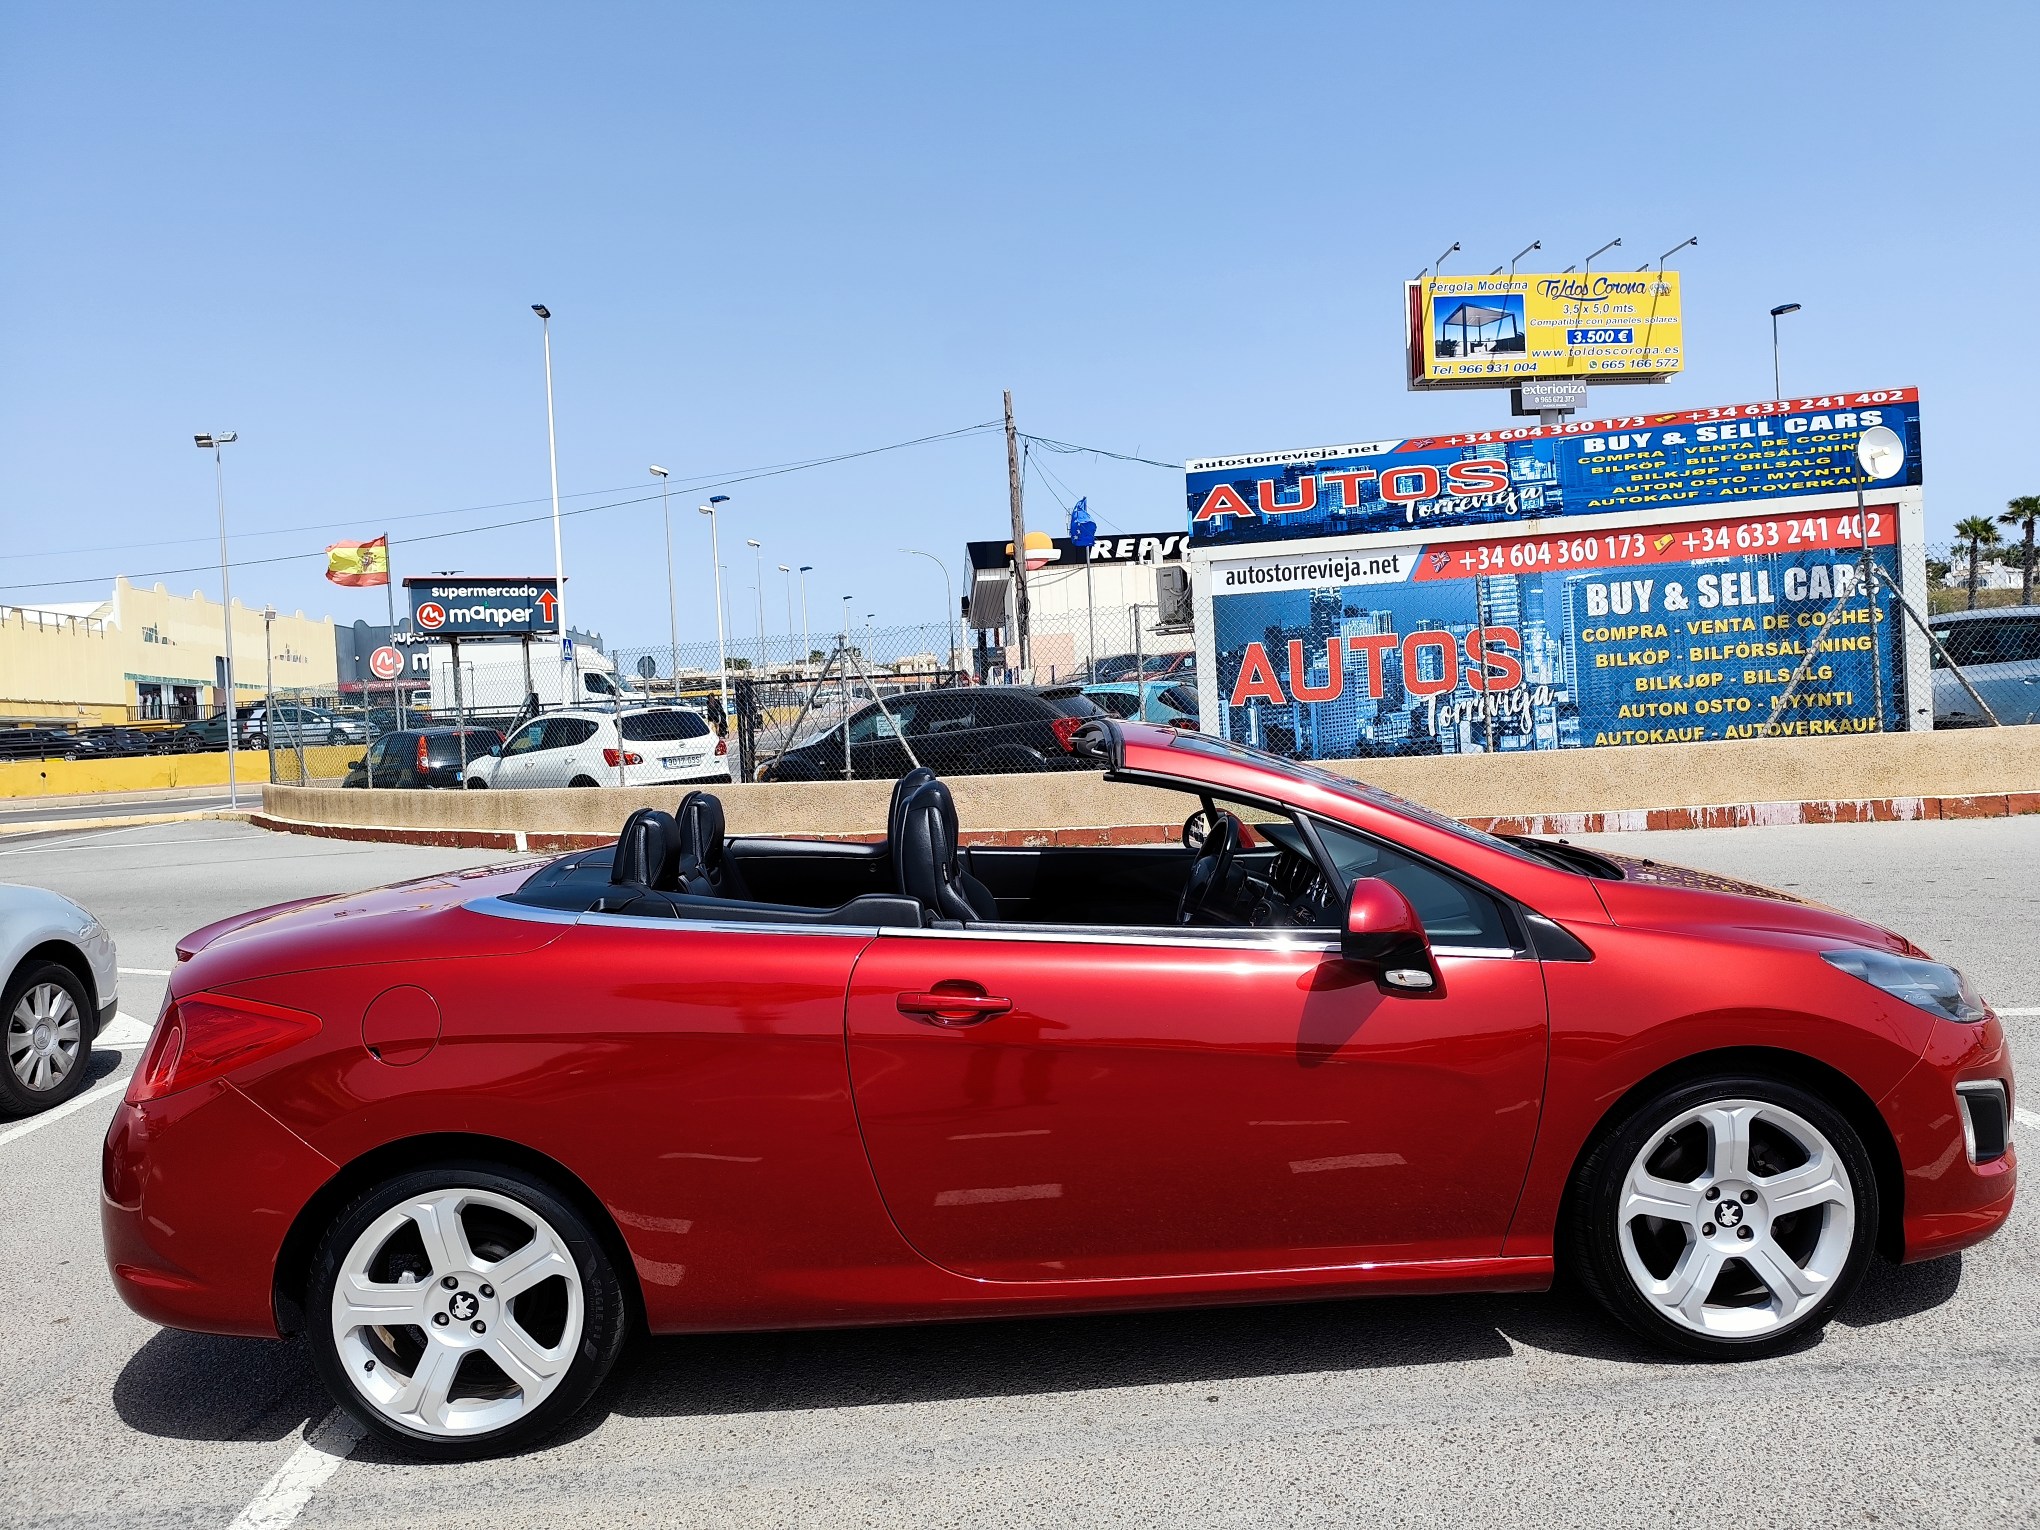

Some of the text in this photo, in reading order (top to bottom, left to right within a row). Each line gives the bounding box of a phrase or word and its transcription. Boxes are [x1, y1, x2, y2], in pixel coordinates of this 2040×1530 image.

[1478, 280, 1528, 291] Moderna
[1537, 277, 1646, 300] Toldos Corona
[1530, 317, 1583, 327] Compatible
[1606, 317, 1642, 326] paneles
[1645, 316, 1678, 324] solares
[1563, 303, 1637, 314] 3,5 x 5,0 mts.
[1573, 330, 1629, 343] 3.500 €
[1531, 346, 1679, 357] www.toldoscorona.es
[1601, 358, 1679, 369] 665 166 572
[1432, 363, 1538, 374] Tel. 966 931 004
[1522, 383, 1586, 395] exterioriza
[1445, 390, 1904, 446] +34 604 360 173 +34 633 241 402
[1583, 410, 1883, 454] BUY & SELL CARS
[1193, 443, 1380, 470] autostorrevieja.net
[1578, 450, 1665, 465] COMPRA
[1684, 441, 1754, 455] VENTA
[1762, 438, 1789, 447] DE
[1796, 431, 1866, 444] COCH
[1591, 461, 1667, 475] BILKÖP
[1686, 443, 1856, 466] BILFÖRSÄLJNIN
[1612, 481, 1683, 494] AUTON
[1690, 475, 1747, 487] OSTO
[1767, 466, 1851, 481] MYYNTI
[1631, 466, 1720, 482] BILKJØP
[1740, 457, 1831, 472] BILSALG
[1192, 459, 1510, 522] AUTOS
[1588, 491, 1700, 507] AUTOKAUF
[1720, 476, 1878, 495] AUTOVERKAUF
[1399, 486, 1543, 523] Torrevieja
[1459, 512, 1881, 571] +34 604 360 173 +34 633 241 402
[1225, 554, 1400, 586] autostorrevieja.net
[431, 584, 538, 600] supermercado
[1586, 579, 1654, 616] BUY
[1663, 582, 1689, 611] &
[1697, 570, 1775, 609] SELL
[449, 604, 534, 627] manper
[1582, 624, 1668, 642] COMPRA
[1687, 617, 1757, 635] VENTA
[1763, 614, 1790, 630] DE
[1595, 648, 1670, 668] BILKÖP
[1689, 635, 1873, 662] BILFÖRSÄLNING
[1230, 626, 1523, 708] AUTOS
[1635, 672, 1724, 692] BILKJØP
[1618, 702, 1688, 719] AUTON
[1695, 697, 1751, 714] OSTO
[1594, 727, 1705, 746] AUTOKAUF
